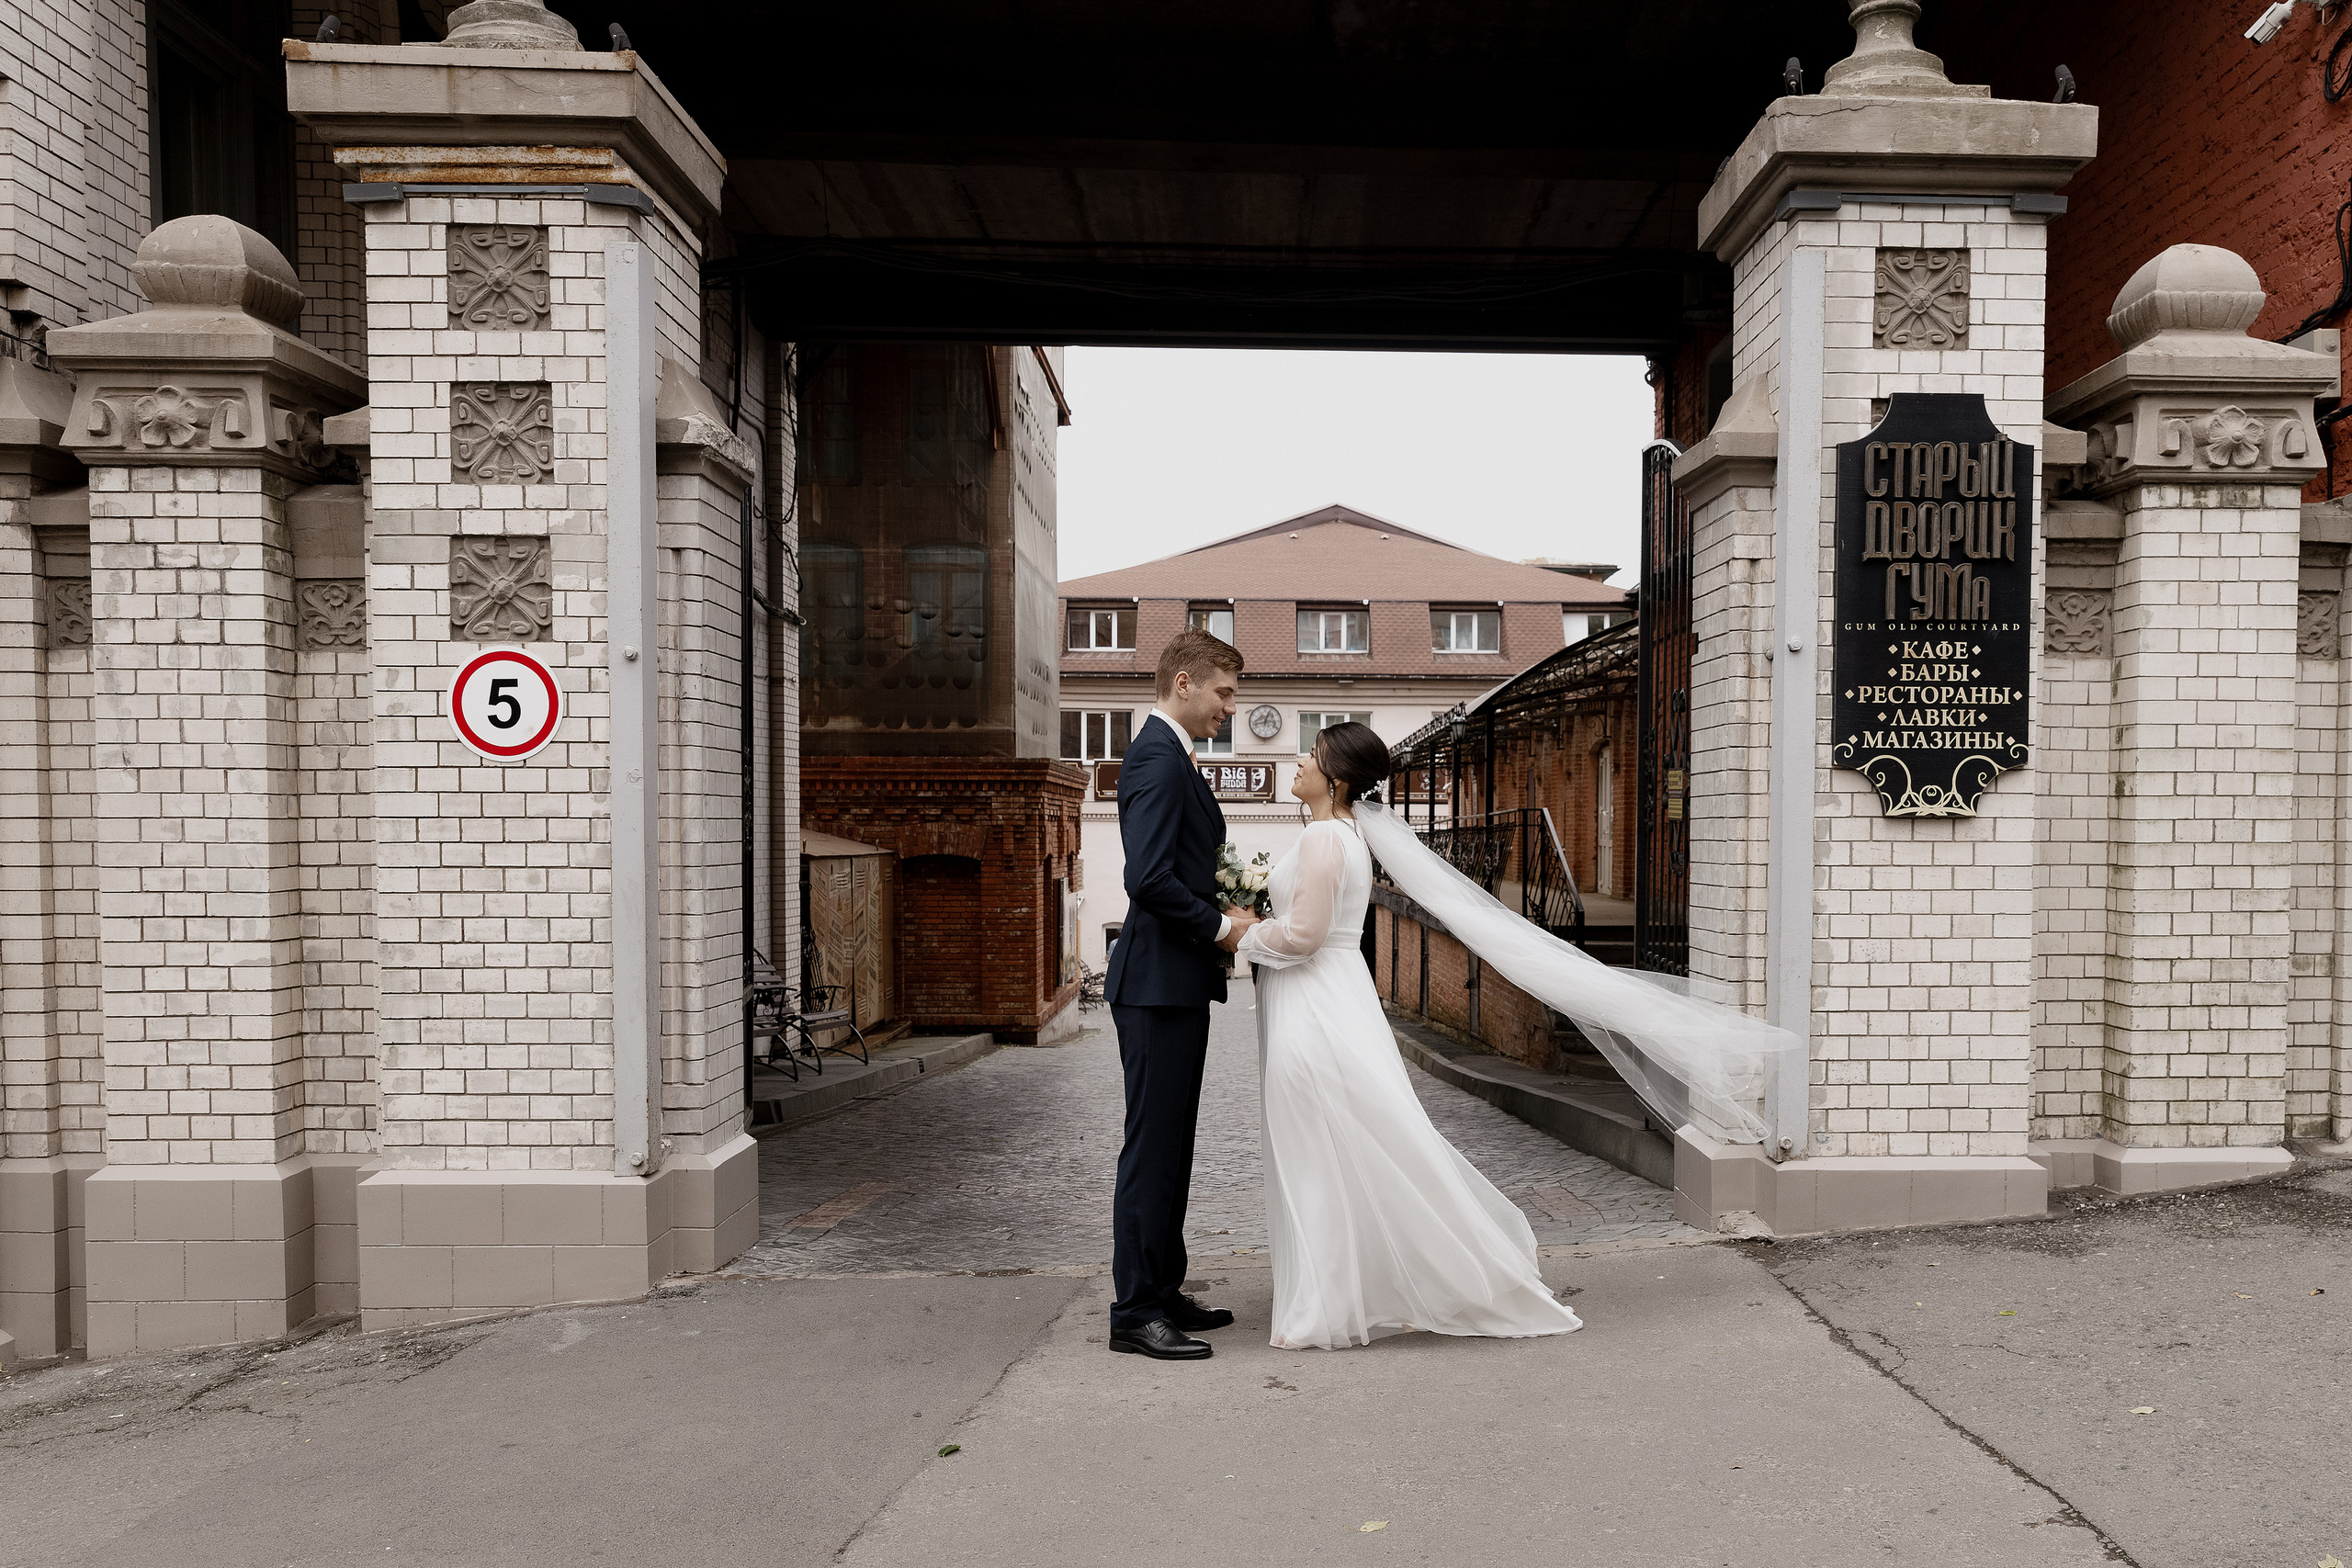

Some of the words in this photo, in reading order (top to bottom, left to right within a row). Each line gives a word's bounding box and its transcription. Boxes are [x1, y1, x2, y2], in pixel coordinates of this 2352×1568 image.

[1864, 434, 2016, 499] СТАРЫЙ
[1862, 501, 2016, 561] ДВОРИК
[1845, 623, 1876, 631] GUM
[1888, 623, 1917, 631] OLD
[1927, 623, 2020, 631] COURTYARD
[1902, 640, 1969, 660] КАФЕ
[1900, 663, 1969, 682] БАРЫ
[487, 678, 522, 729] 5
[1858, 685, 2011, 705] РЕСТОРАНЫ
[1890, 708, 1976, 727] ЛАВКИ
[1861, 730, 2004, 750] МАГАЗИНЫ
